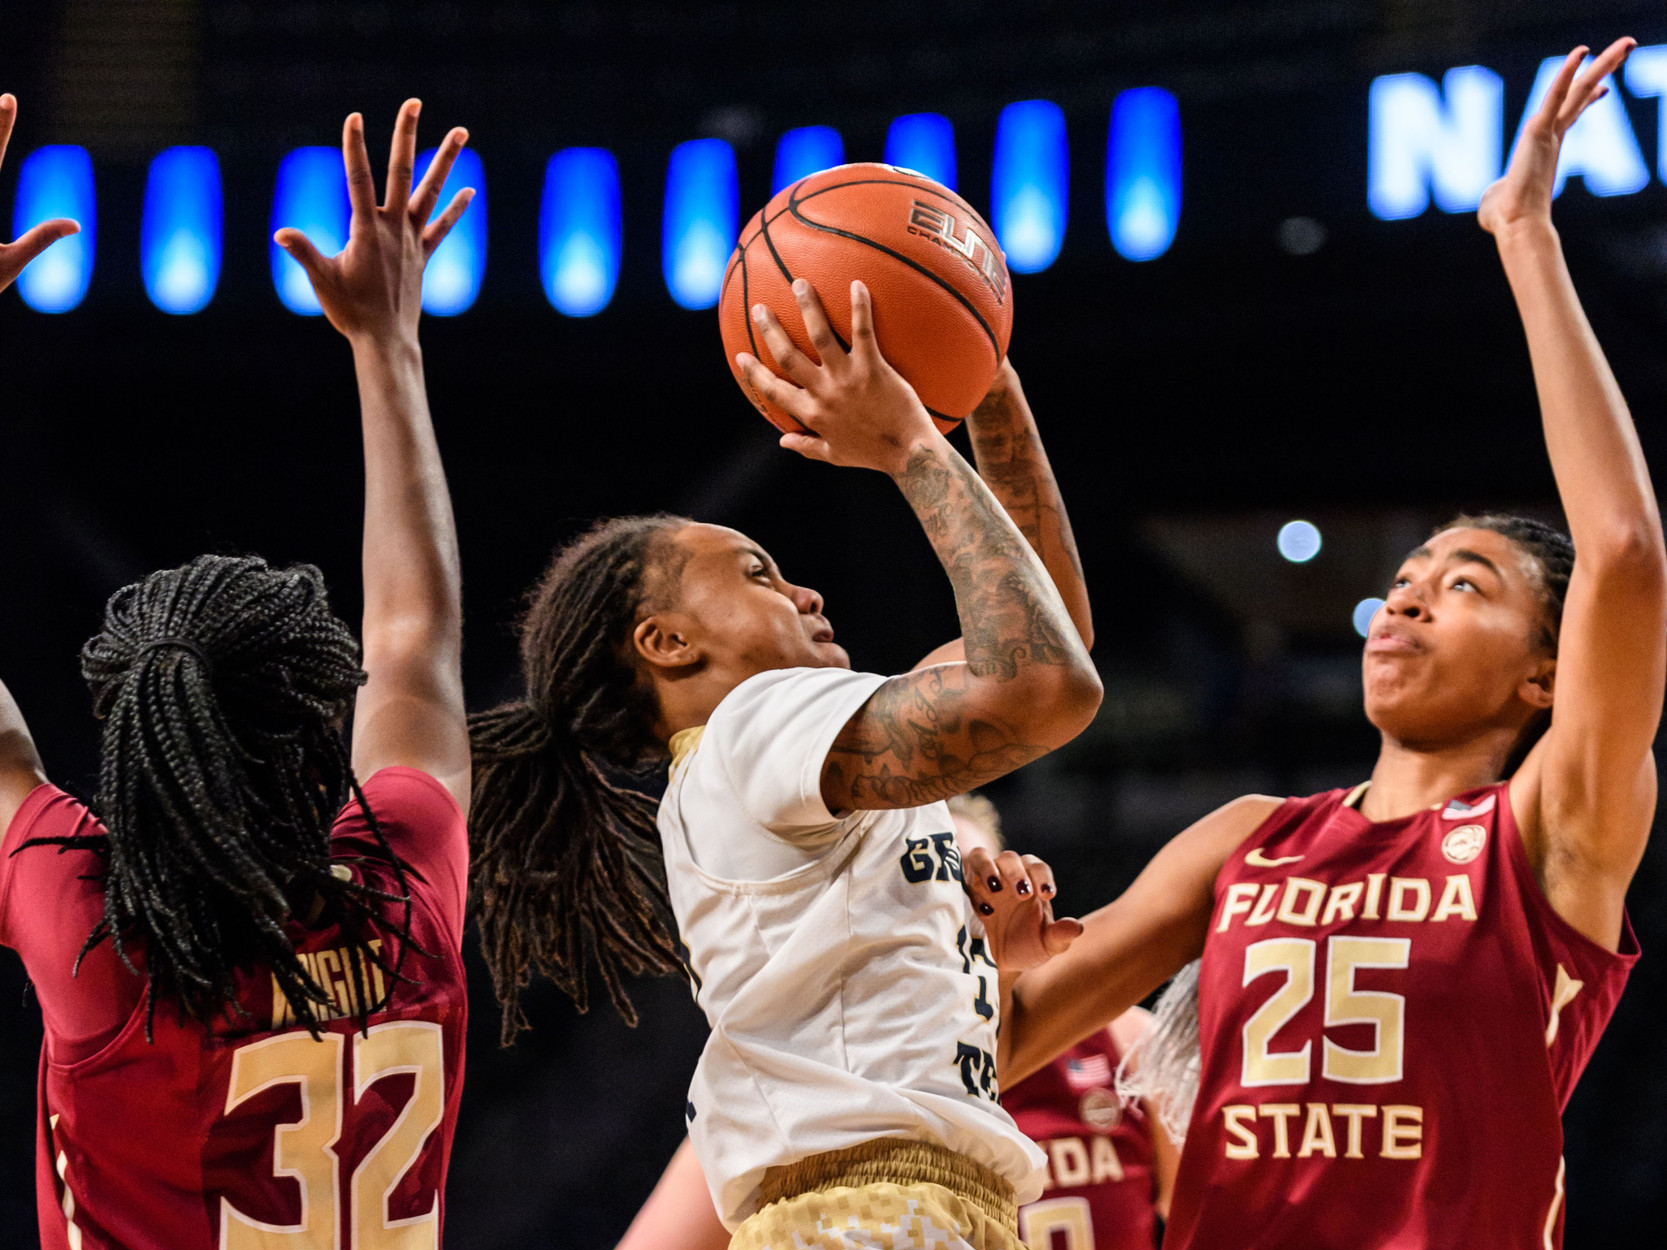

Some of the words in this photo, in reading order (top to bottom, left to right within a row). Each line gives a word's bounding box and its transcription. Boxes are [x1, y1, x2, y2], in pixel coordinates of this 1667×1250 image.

[908, 199, 1007, 300] ELITE
[899, 831, 966, 886] GE
[1216, 873, 1478, 934] FLORIDA
[1240, 935, 1411, 1087] 25
[952, 1040, 1002, 1106] TE
[1221, 1102, 1423, 1160] STATE
